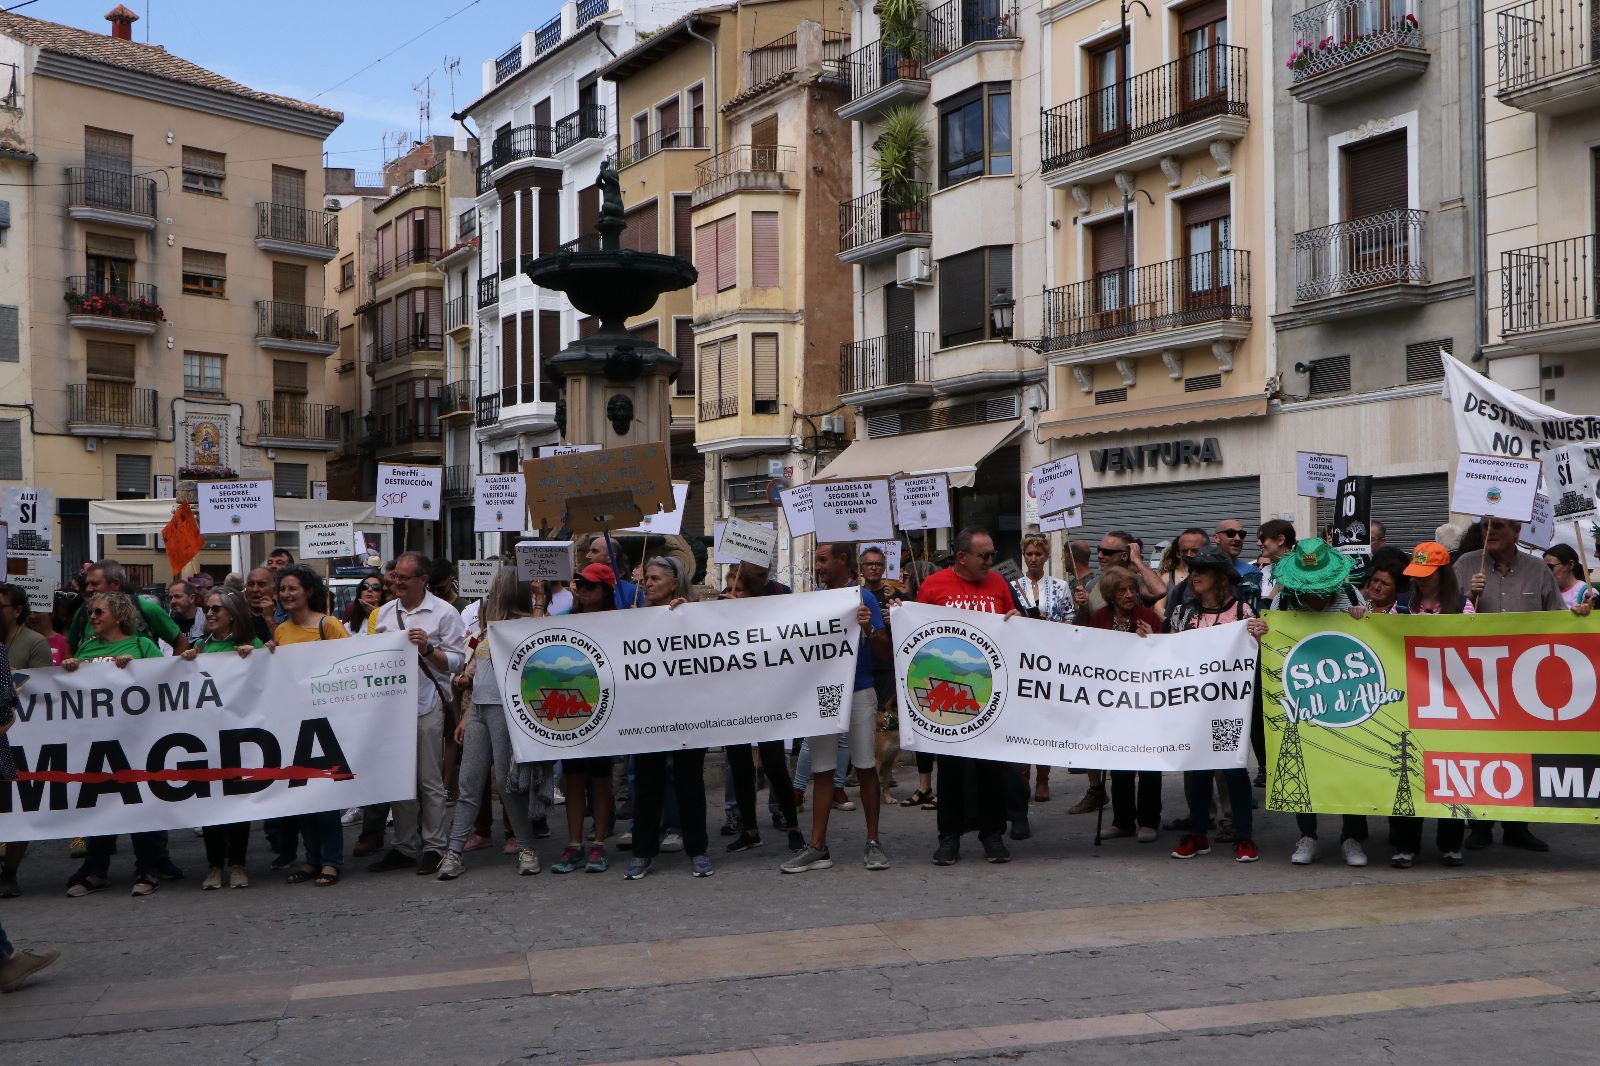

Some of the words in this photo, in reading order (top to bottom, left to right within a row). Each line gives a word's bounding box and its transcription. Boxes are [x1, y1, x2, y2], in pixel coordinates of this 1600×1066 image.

[1464, 392, 1538, 435] DESTRUIR
[1089, 438, 1222, 472] VENTURA
[1493, 432, 1523, 456] NO
[769, 460, 783, 474] P
[1038, 468, 1072, 484] DESTRUCCIÓN
[1042, 462, 1061, 474] EnerHi
[1468, 458, 1528, 469] MACROPROYECTOS
[1557, 461, 1572, 486] SÍ
[384, 478, 432, 486] DESTRUCCIÓN
[792, 486, 811, 496] ALCALD
[824, 484, 862, 492] ALCALDESA
[20, 492, 38, 500] AIXÍ
[382, 492, 408, 508] STOP
[824, 500, 864, 508] CALDERONA
[20, 502, 37, 524] SÍ
[622, 638, 652, 656] NO
[656, 630, 740, 653] VENDAS
[746, 628, 772, 644] EL
[776, 618, 848, 640] VALLE,
[902, 626, 967, 655] PLATAFORMA
[970, 632, 1002, 670] CONTRA
[512, 634, 568, 672] PLATAFORMA
[570, 636, 605, 668] CONTRA
[624, 662, 657, 680] NO
[662, 652, 758, 678] VENDAS
[764, 648, 794, 668] LA
[799, 640, 854, 663] VIDA
[337, 658, 406, 674] ASSOCIACIÓ
[1020, 652, 1052, 672] NO
[1058, 662, 1194, 684] MACROCENTRAL
[1200, 658, 1254, 675] SOLAR
[1290, 652, 1376, 690] S.O.S.
[310, 680, 358, 694] Nostra
[363, 674, 407, 688] Terra
[1018, 678, 1050, 700] EN
[1059, 684, 1090, 705] LA
[1097, 680, 1252, 710] CALDERONA
[1414, 644, 1597, 722] NO
[16, 672, 224, 722] VINROMÀ
[312, 698, 326, 706] LES
[330, 694, 355, 704] COVES
[358, 692, 368, 700] DE
[1280, 692, 1328, 724] Vall
[512, 694, 520, 708] LA
[517, 708, 578, 742] FOTOVOLTAICA
[578, 688, 610, 737] CALDERONA
[618, 711, 798, 736] www.contrafotovoltaicacalderona.es
[960, 690, 1002, 735] CALDERONA
[1005, 735, 1191, 753] www.contrafotovoltaicacalderona.es
[0, 717, 354, 813] MAGDA
[1432, 759, 1524, 800] NO
